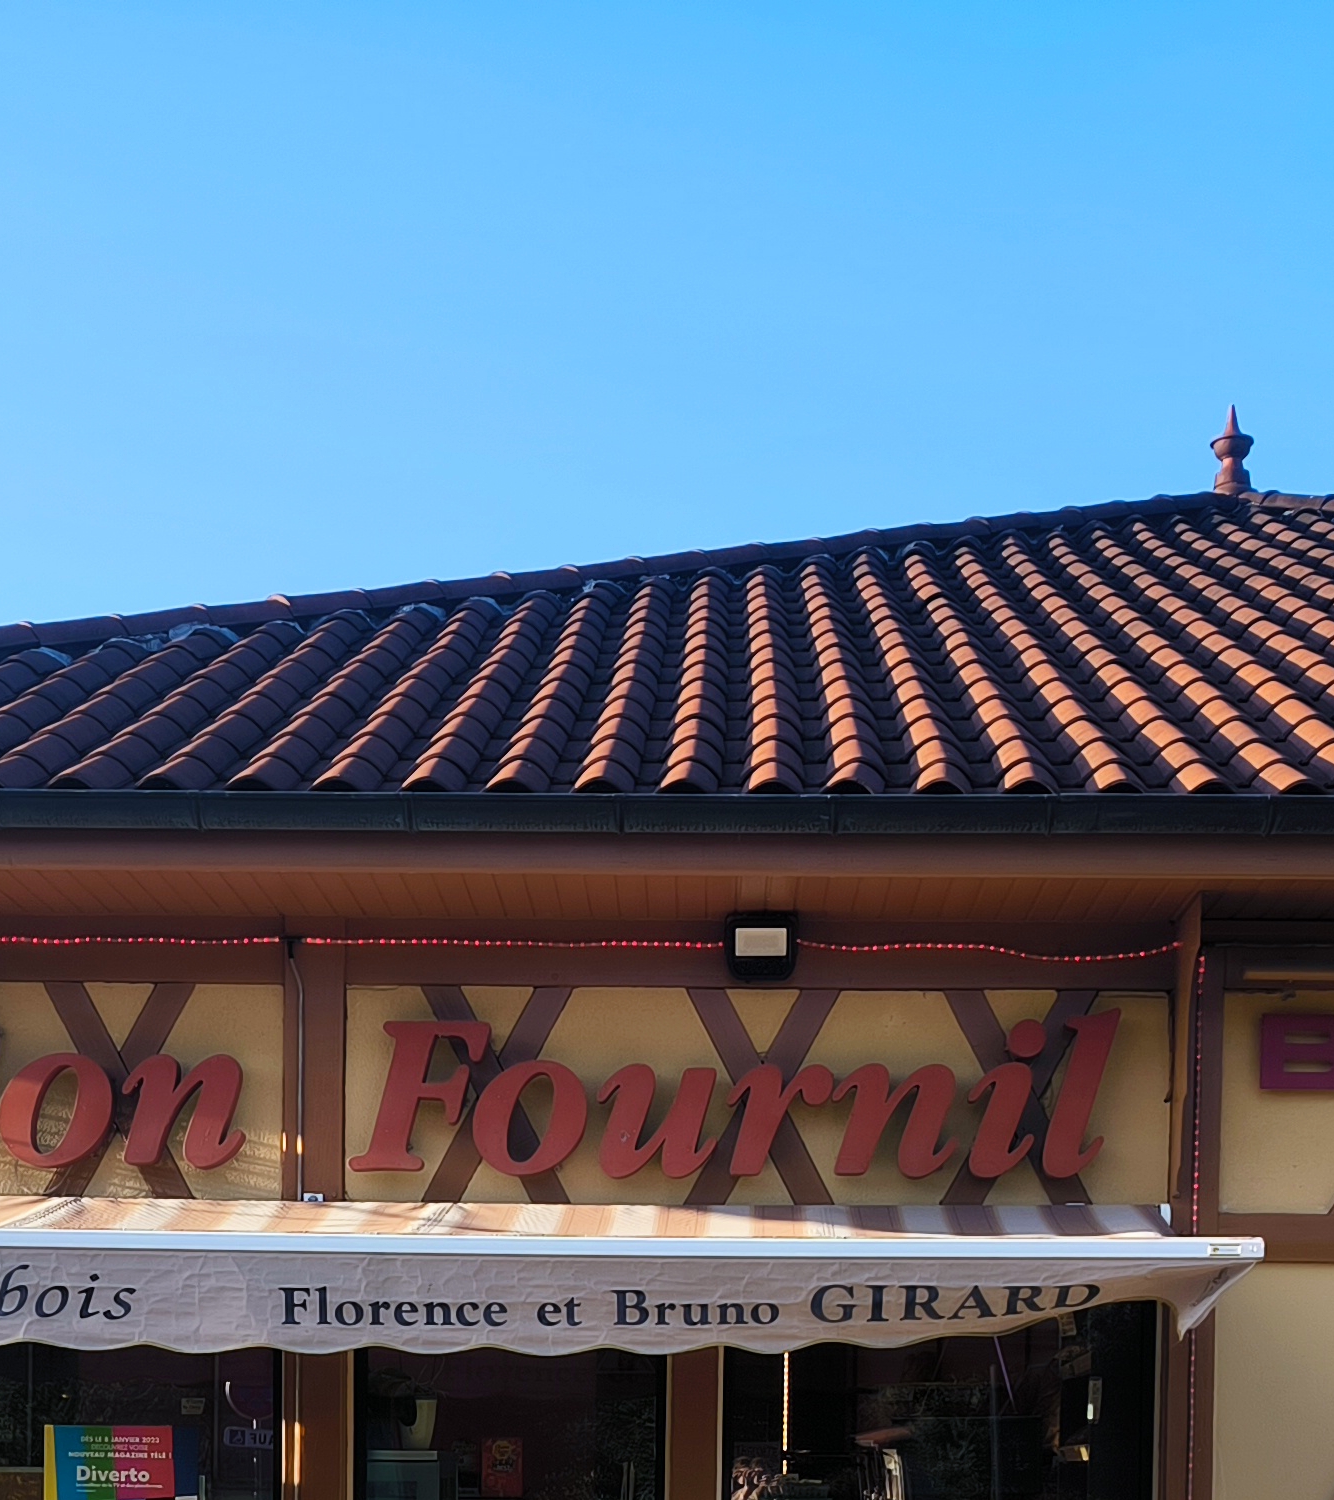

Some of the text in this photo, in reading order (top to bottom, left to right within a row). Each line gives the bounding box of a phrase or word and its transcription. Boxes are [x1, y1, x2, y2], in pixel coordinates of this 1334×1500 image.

[347, 1008, 1122, 1179] Fournil
[278, 1283, 1101, 1328] Florence et Bruno GIRARD
[75, 1465, 150, 1482] Diverto
